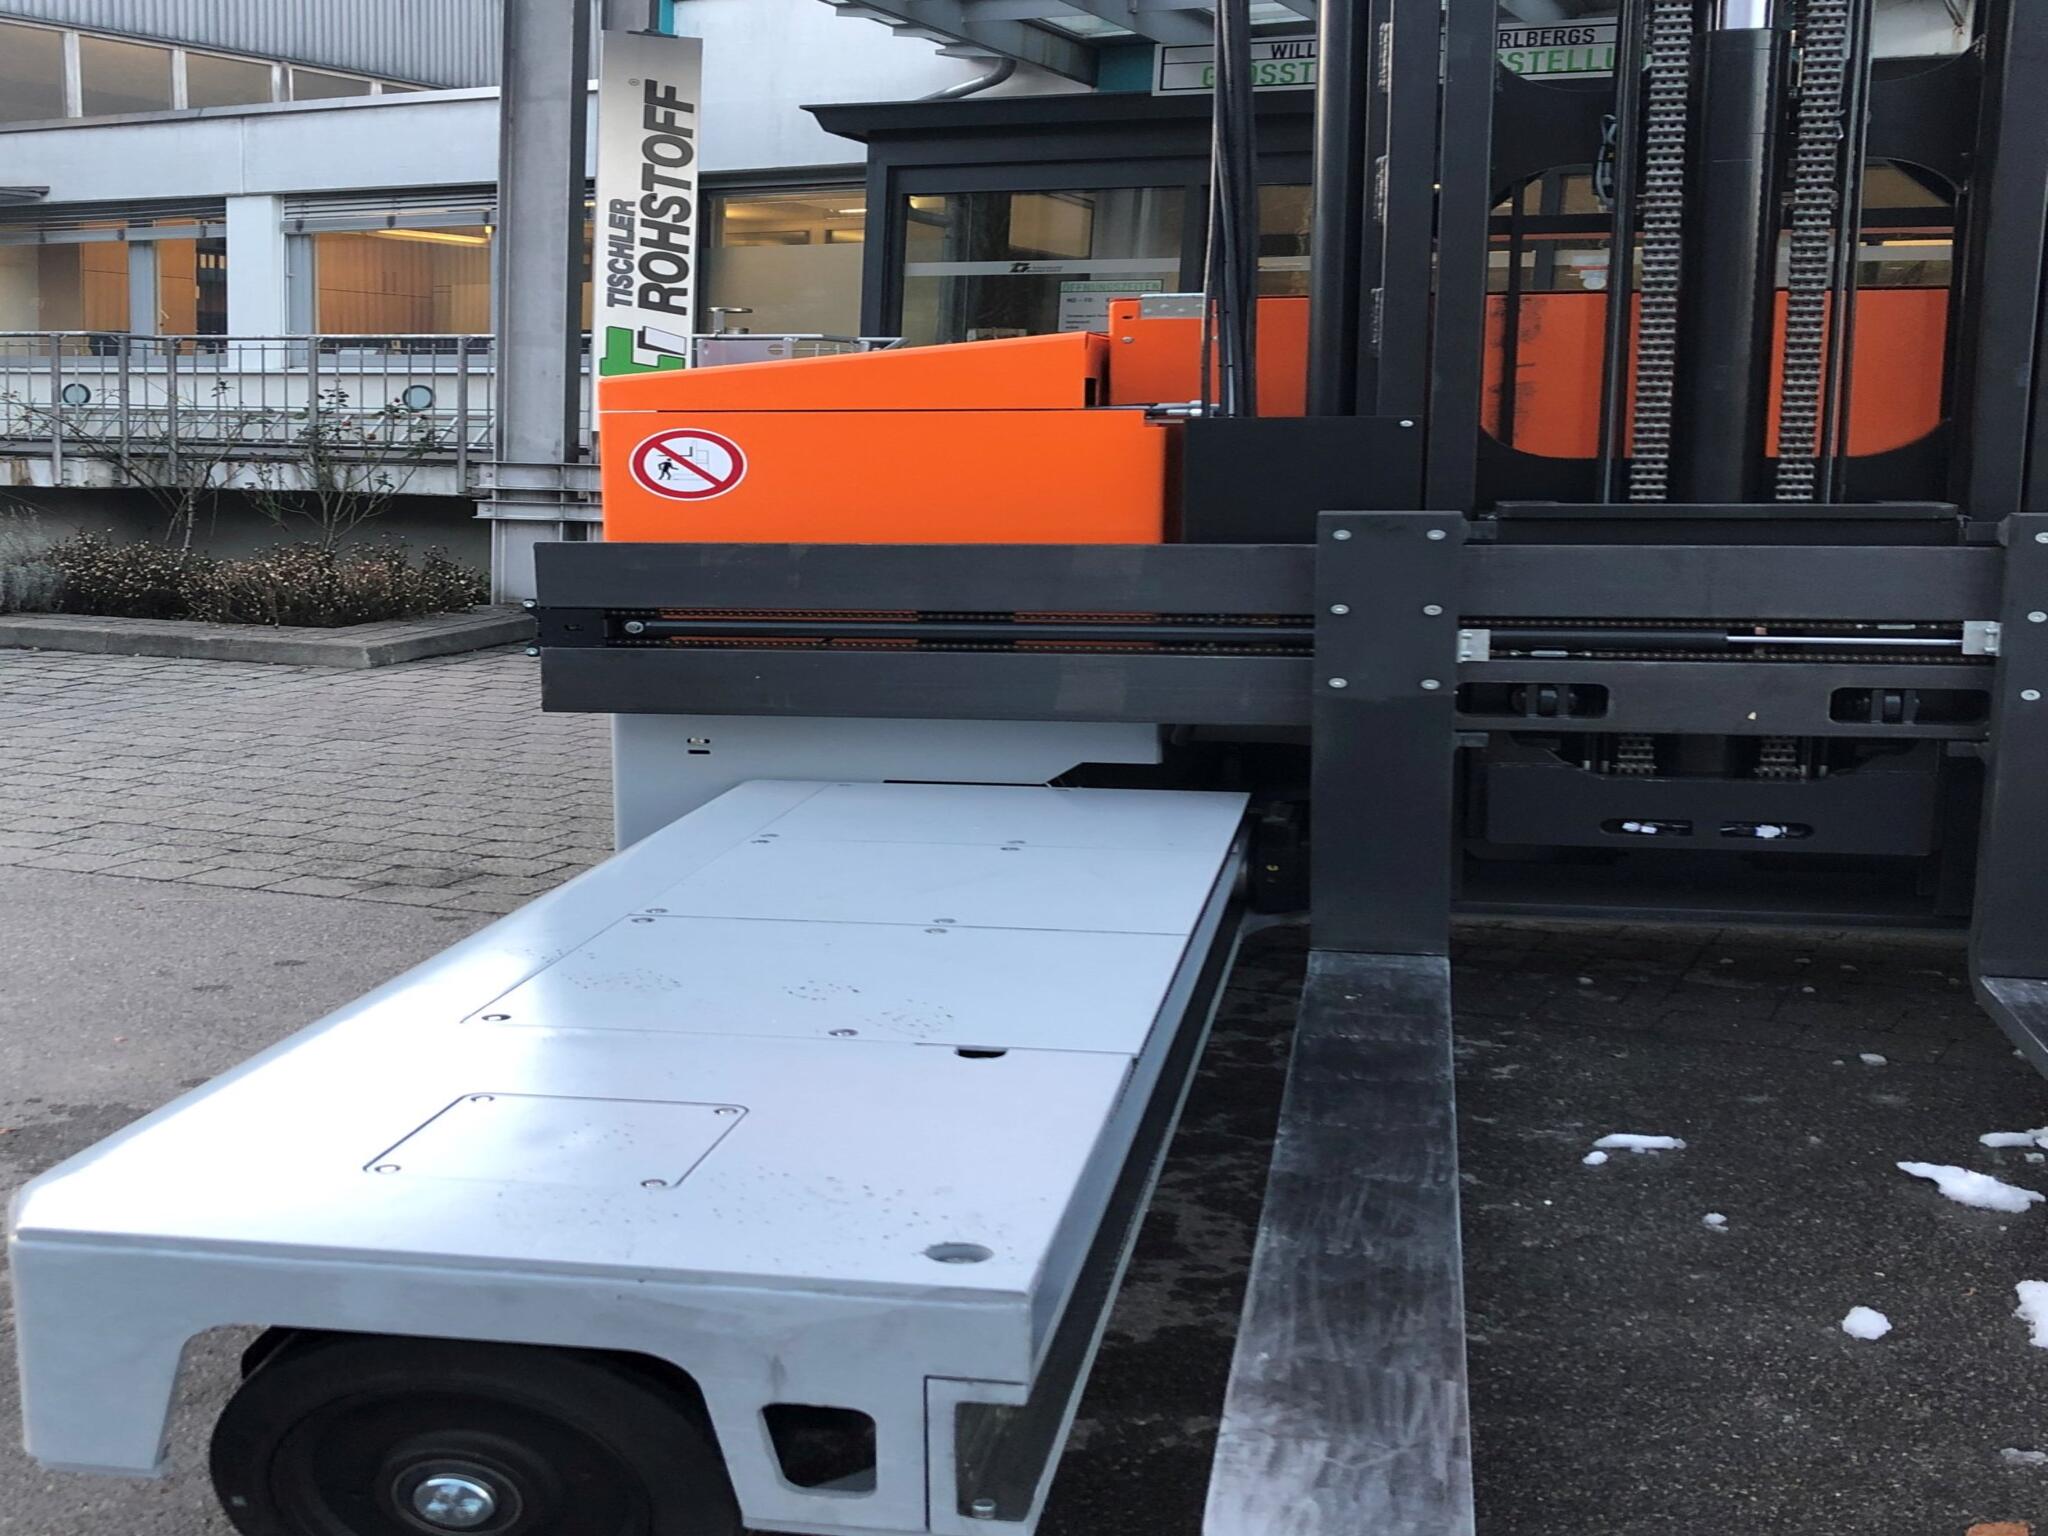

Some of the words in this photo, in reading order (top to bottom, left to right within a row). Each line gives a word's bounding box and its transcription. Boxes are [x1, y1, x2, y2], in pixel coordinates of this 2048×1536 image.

[1202, 61, 1316, 87] GSST
[1498, 47, 1614, 74] STELL
[1271, 43, 1316, 59] WILL
[1500, 28, 1596, 48] RLBERGS
[638, 78, 694, 316] ROHSTOFF
[607, 198, 636, 308] TISCHLER
